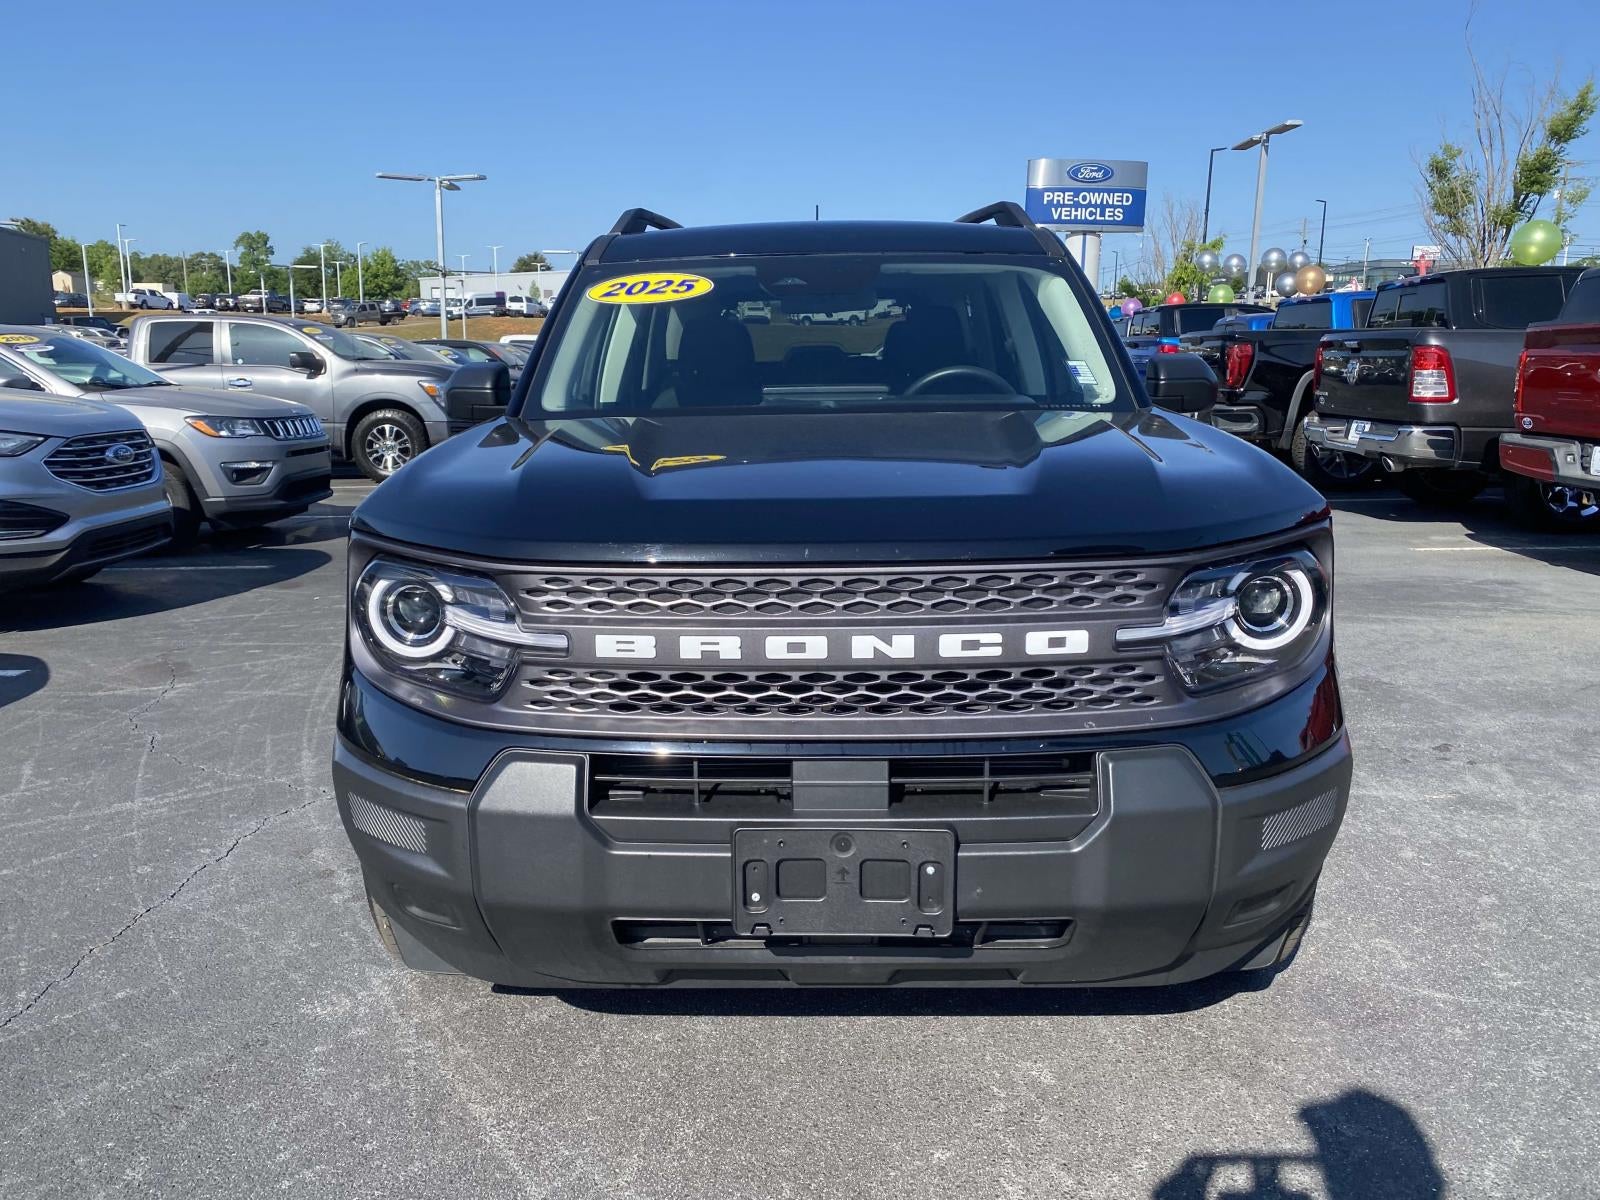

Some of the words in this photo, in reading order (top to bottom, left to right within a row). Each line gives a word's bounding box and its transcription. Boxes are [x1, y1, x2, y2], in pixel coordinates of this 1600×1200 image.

[1077, 166, 1104, 179] Ford
[1043, 191, 1133, 206] PRE-OWNED
[1051, 207, 1124, 221] VEHICLES
[598, 279, 700, 298] 2025
[595, 629, 1089, 660] BRONCO
